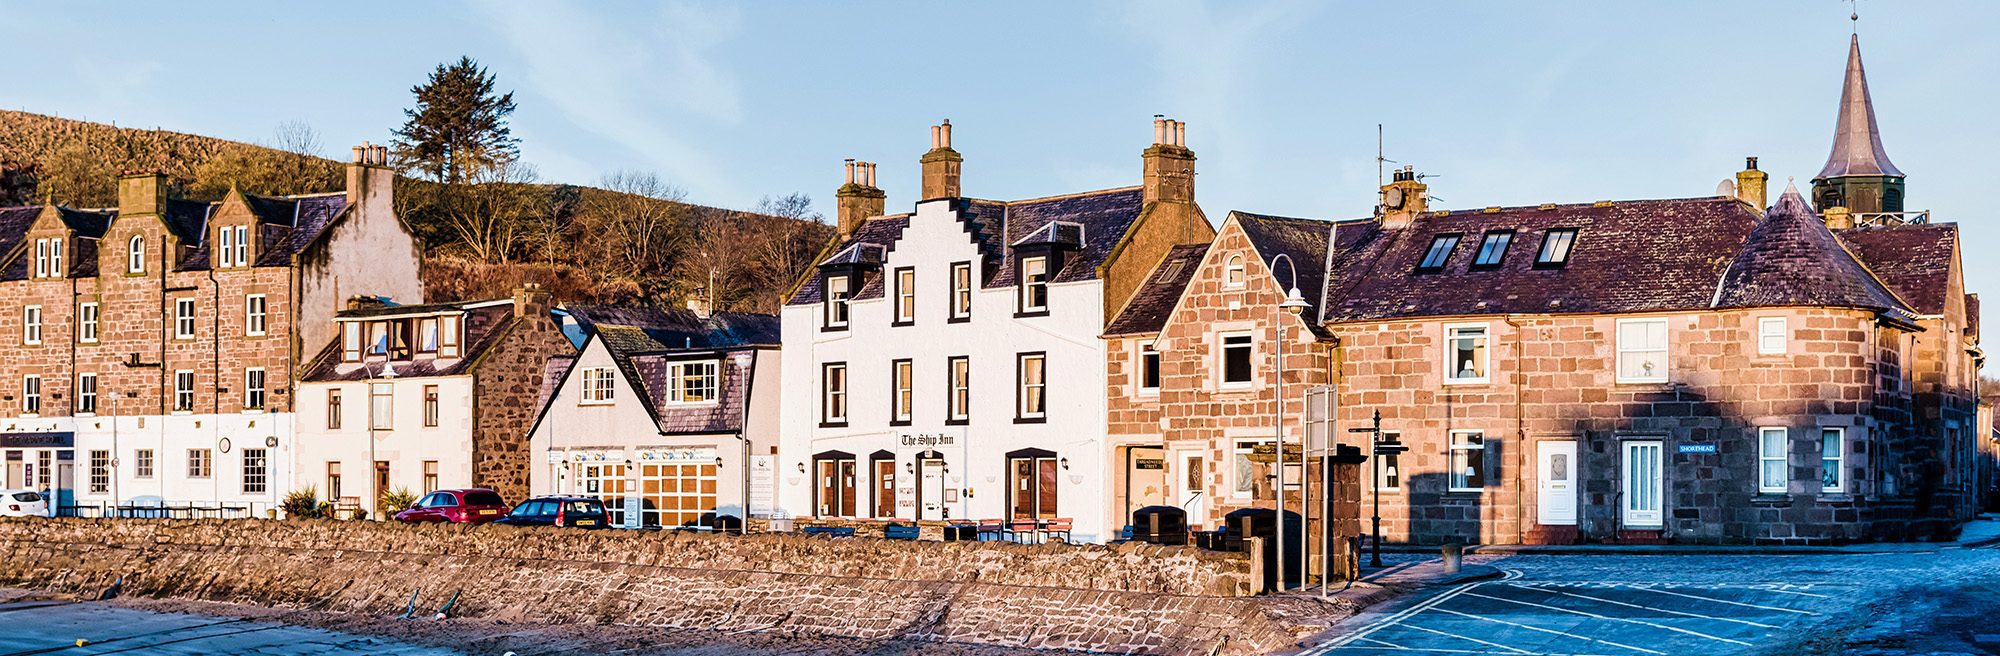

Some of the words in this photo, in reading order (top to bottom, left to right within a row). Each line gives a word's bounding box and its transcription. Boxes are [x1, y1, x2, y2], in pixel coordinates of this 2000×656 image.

[902, 434, 916, 447] The
[917, 433, 937, 447] Ship
[938, 433, 954, 445] Inn
